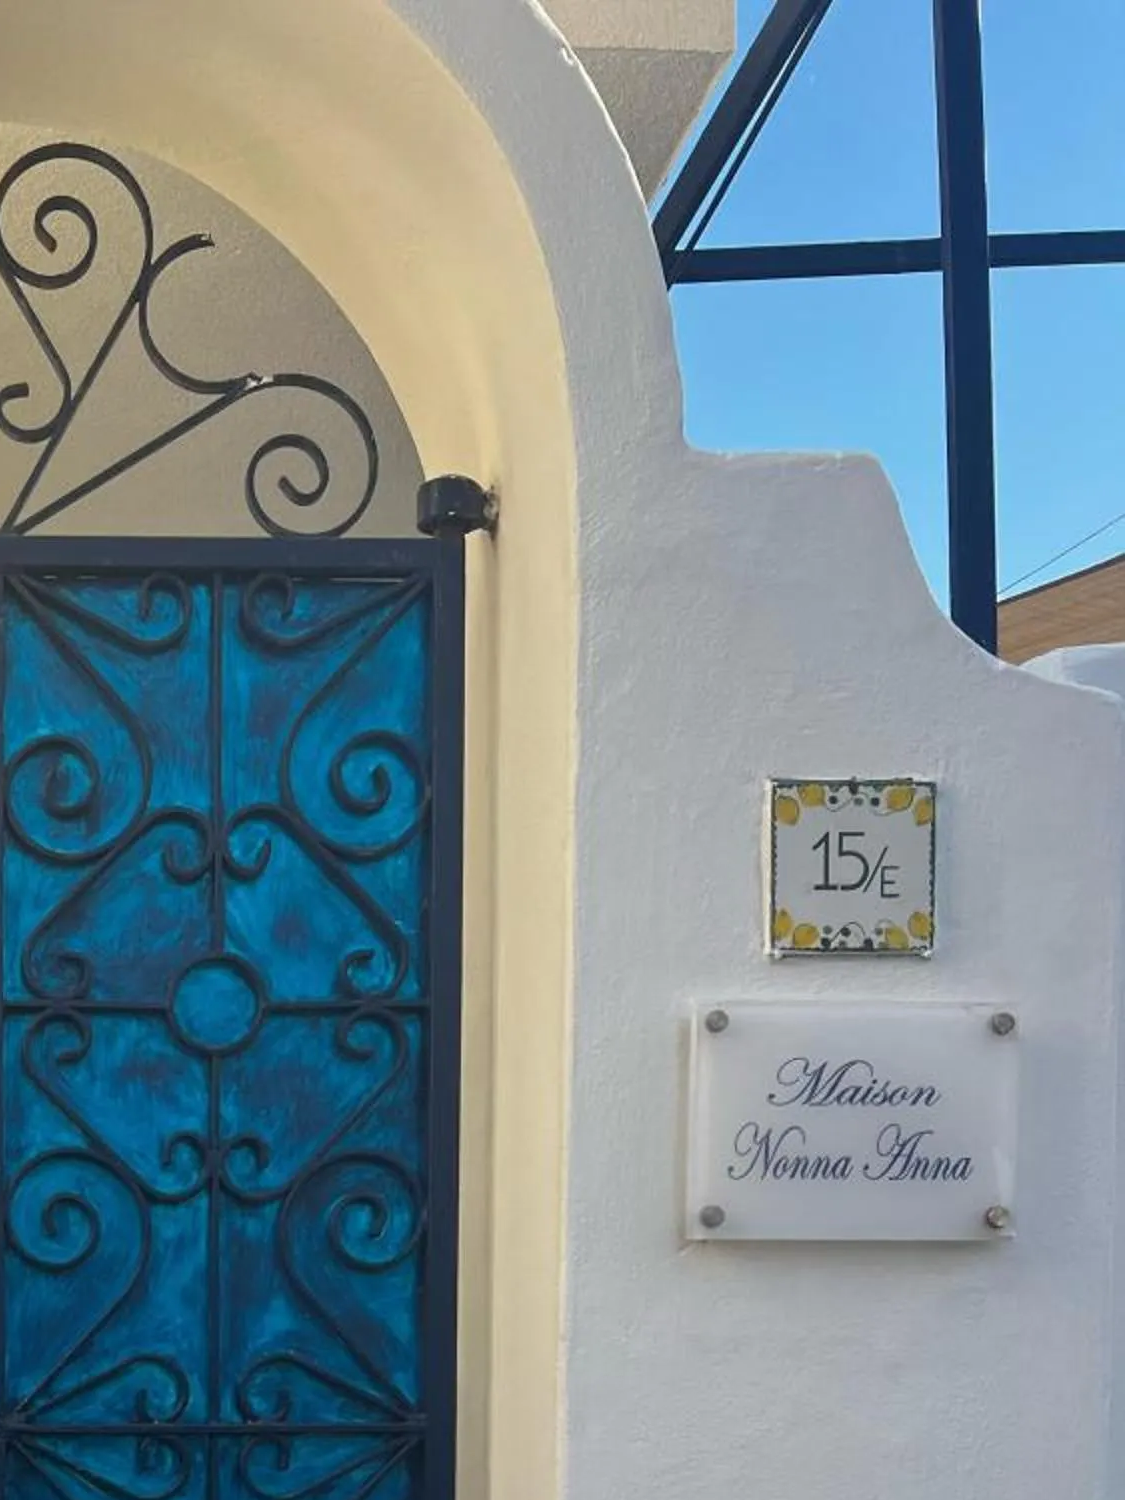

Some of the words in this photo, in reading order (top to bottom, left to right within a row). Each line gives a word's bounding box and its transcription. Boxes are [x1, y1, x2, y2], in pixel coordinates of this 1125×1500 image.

[812, 831, 901, 899] 15/E
[767, 1057, 941, 1107] Maison
[727, 1121, 854, 1181] Nonna
[863, 1123, 973, 1182] Anna
